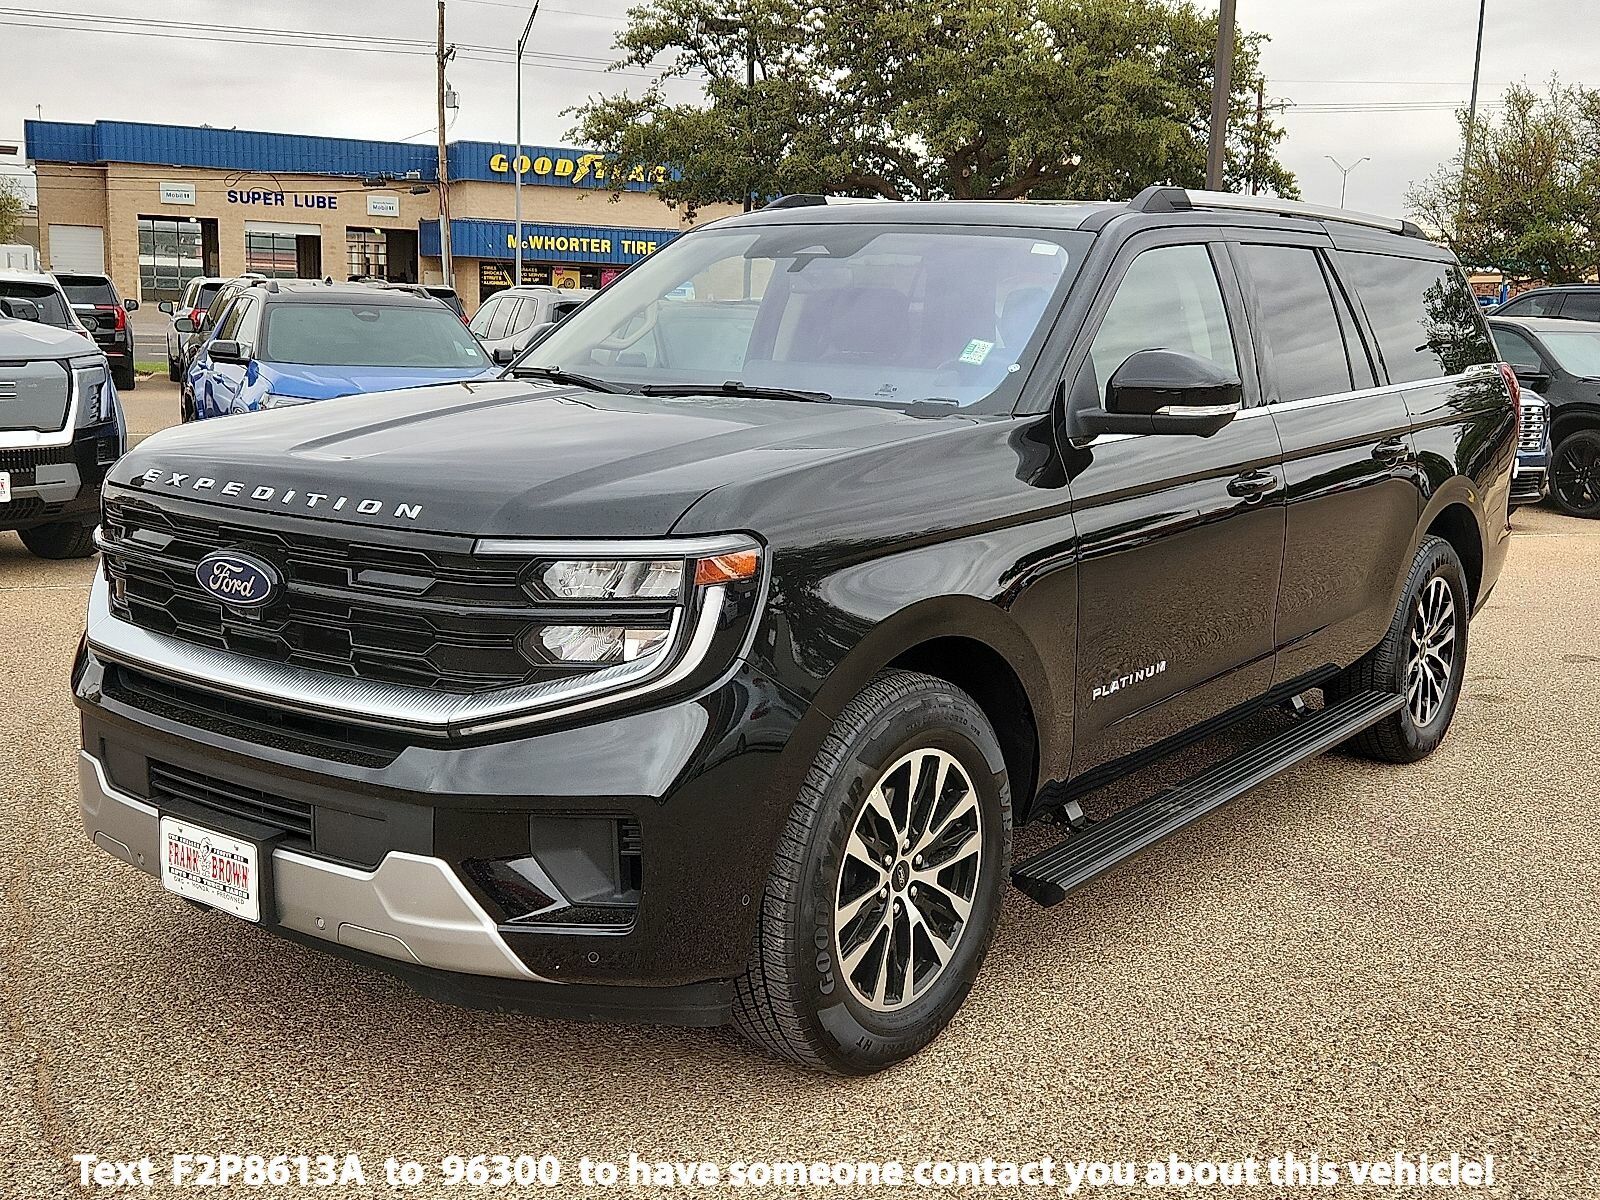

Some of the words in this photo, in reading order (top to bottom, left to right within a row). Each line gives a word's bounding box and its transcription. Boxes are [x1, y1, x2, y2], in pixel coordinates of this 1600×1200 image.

[227, 190, 285, 206] SUPER
[294, 194, 338, 210] LUBE
[507, 234, 611, 254] McWHORTER
[621, 240, 657, 255] TIRE
[142, 468, 424, 520] EXPEDITION
[209, 561, 255, 598] Ford
[1092, 660, 1167, 701] PLATINUM
[168, 841, 199, 872] FRANK
[211, 856, 247, 888] BROWN
[855, 1036, 873, 1051] HT
